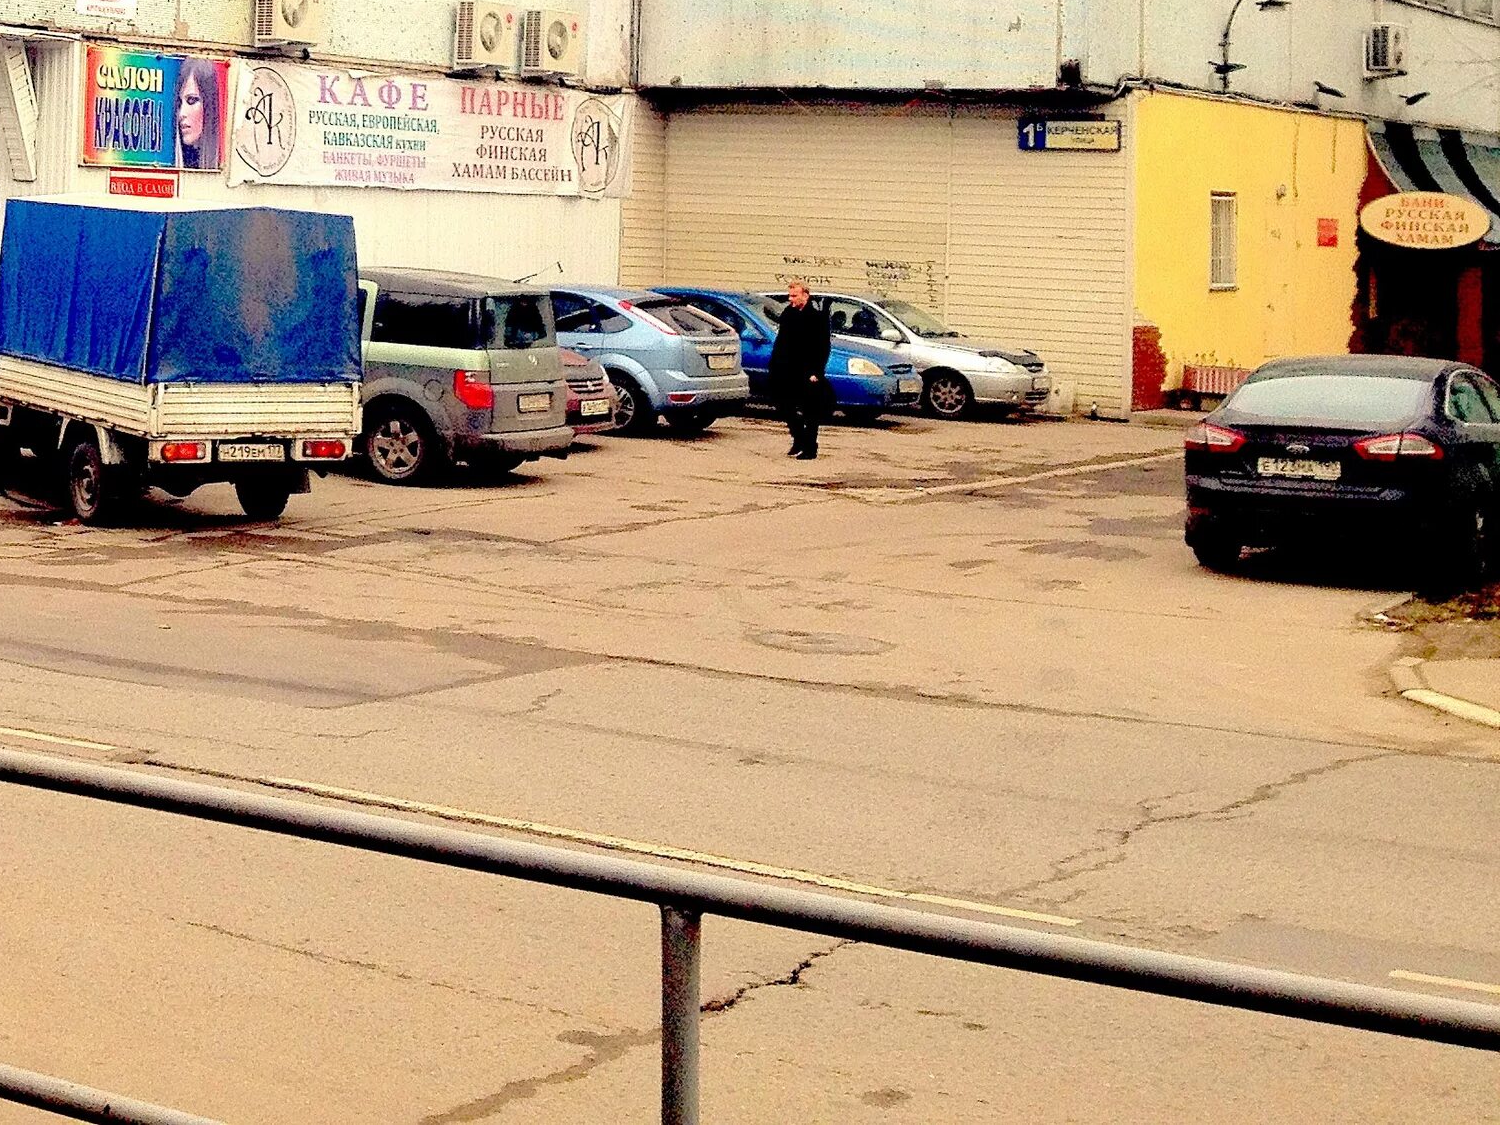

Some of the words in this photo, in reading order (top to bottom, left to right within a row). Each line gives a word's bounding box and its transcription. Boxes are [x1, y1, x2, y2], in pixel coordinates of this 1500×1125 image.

[96, 65, 164, 93] САЛОН
[316, 74, 429, 111] КАФЕ
[460, 86, 565, 121] ПАРНЫЕ
[93, 96, 164, 153] КРАСОТЫ
[308, 109, 360, 130] РУССКАЯ,
[323, 130, 393, 150] КАВКАЗСКАЯ
[480, 124, 544, 143] РУССКАЯ
[376, 153, 426, 169] ФУРШЕТЫ
[476, 143, 547, 162] ФИНСКАЯ
[334, 168, 371, 183] ЖИВАЯ
[373, 169, 415, 185] МУЗЫКА
[451, 162, 507, 179] ХАМАМ
[510, 165, 573, 182] БАССЕЙН
[1385, 208, 1465, 221] РУССКАЯ
[1380, 220, 1470, 234] ФИНСКАЯ
[1395, 232, 1454, 244] ХАМАМ
